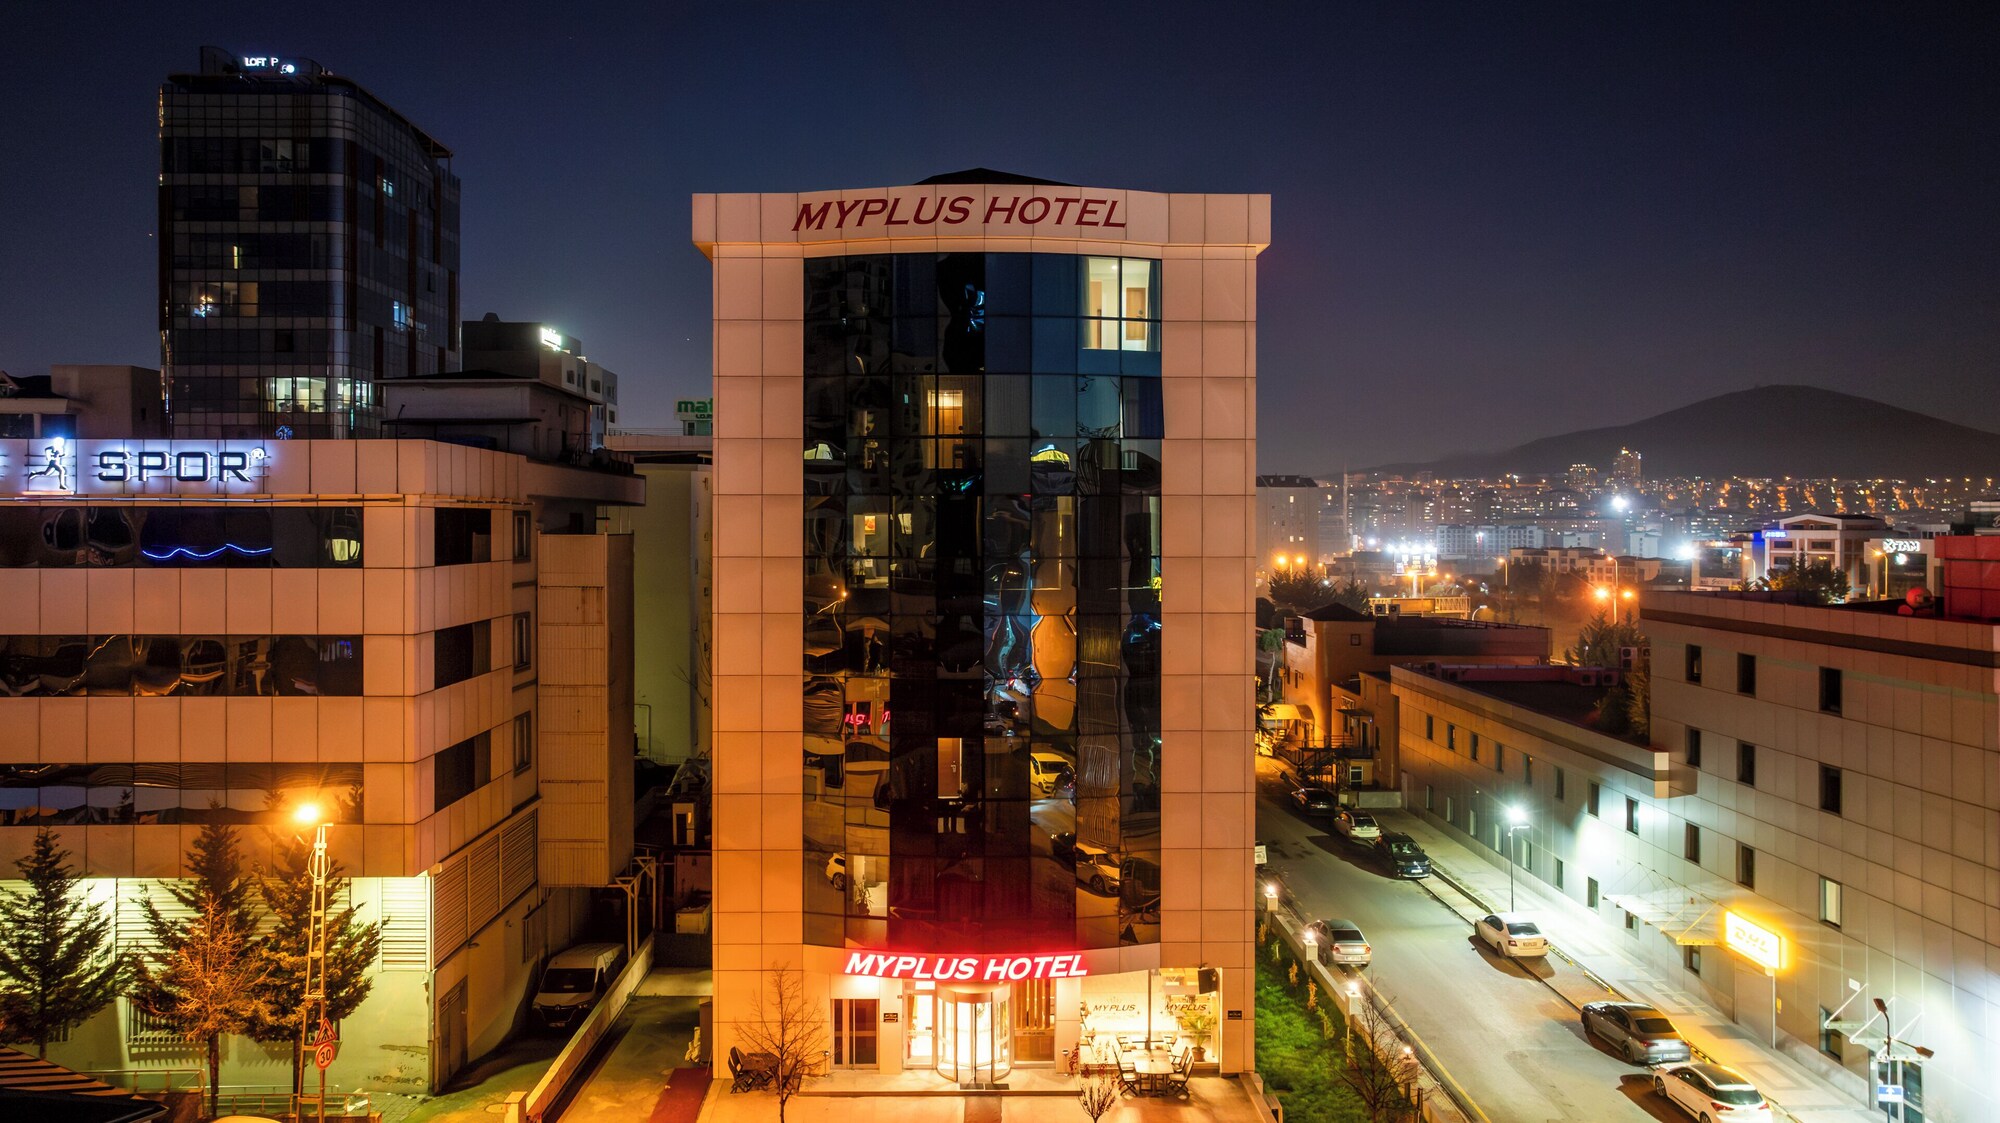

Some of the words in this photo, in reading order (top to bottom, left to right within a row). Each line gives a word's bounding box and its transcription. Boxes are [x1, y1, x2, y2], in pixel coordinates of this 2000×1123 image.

[244, 57, 267, 67] LOFT
[791, 196, 975, 232] MYPLUS
[982, 196, 1127, 229] HOTEL
[98, 451, 252, 482] SPOR
[844, 952, 980, 981] MYPLUS
[983, 954, 1088, 981] HOTEL
[320, 1049, 331, 1064] 30
